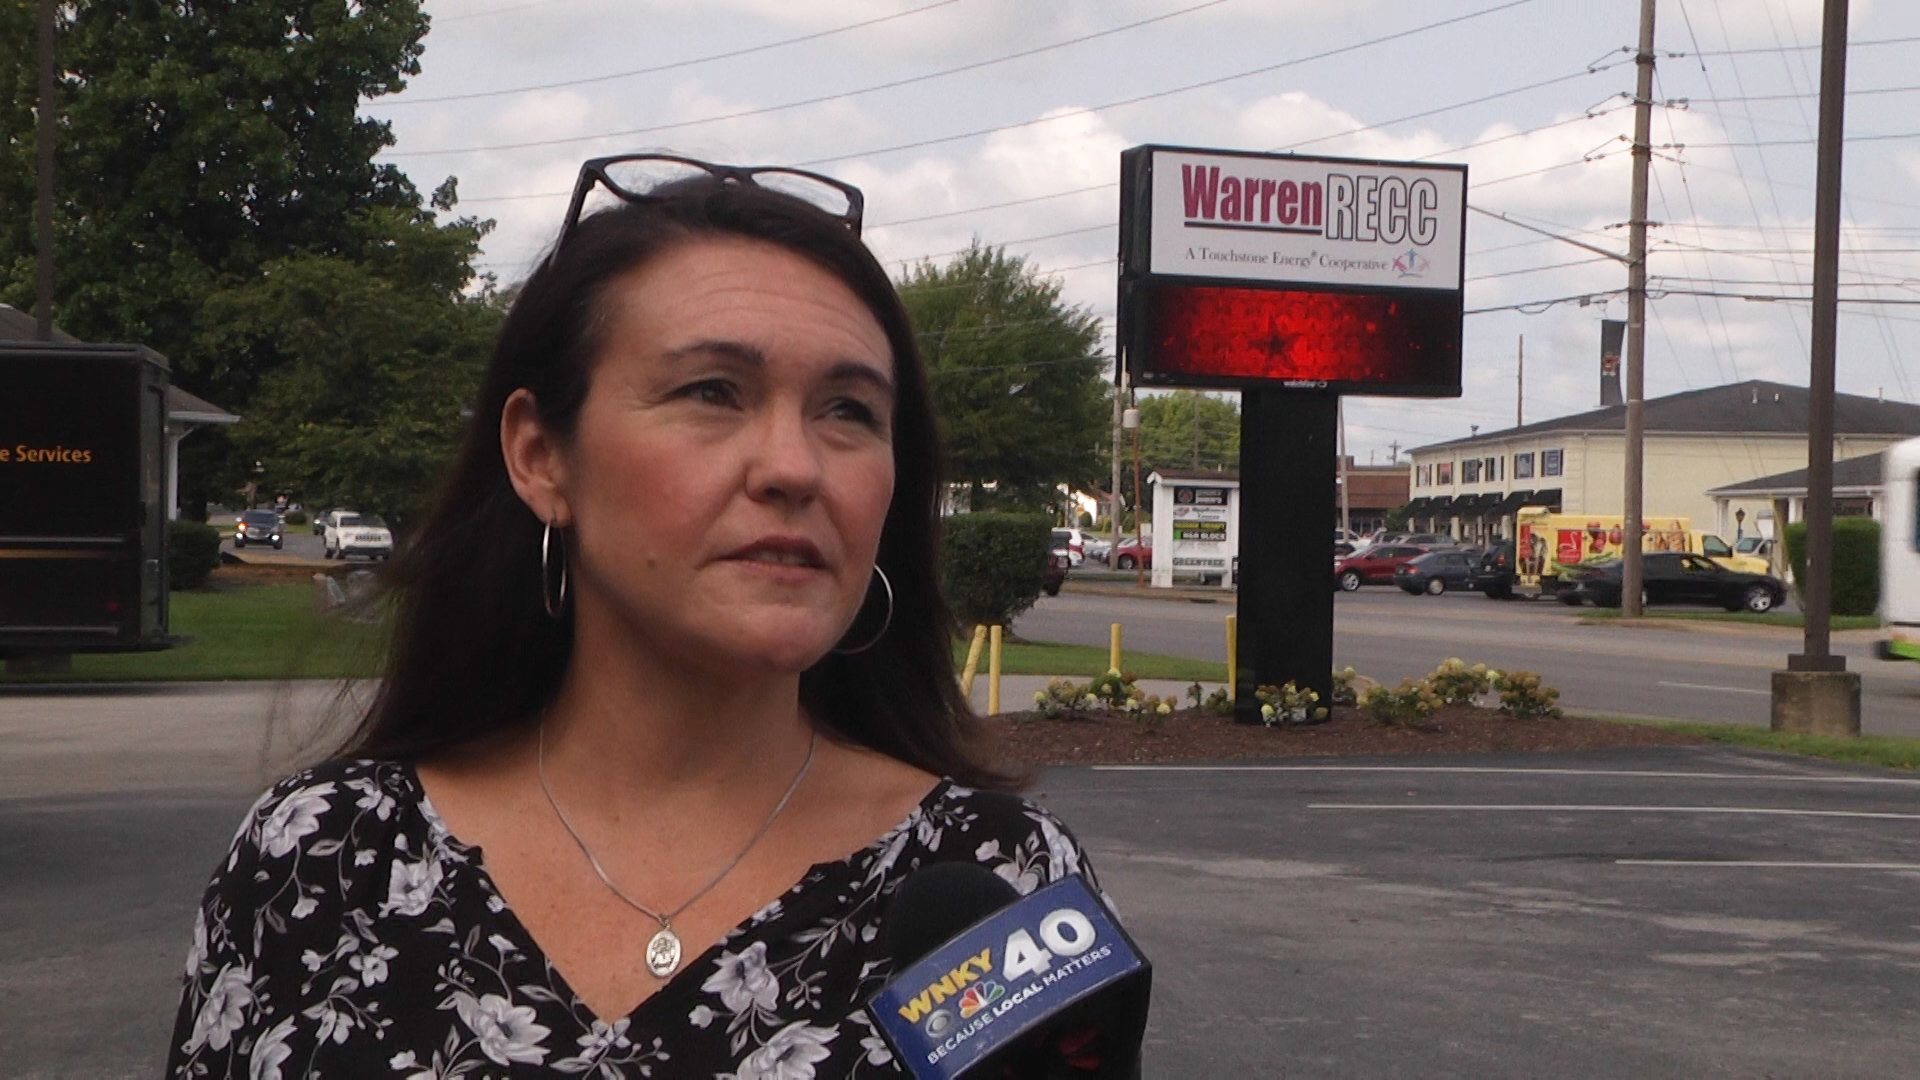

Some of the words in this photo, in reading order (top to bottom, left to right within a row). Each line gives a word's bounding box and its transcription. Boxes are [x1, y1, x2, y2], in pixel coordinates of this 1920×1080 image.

[1185, 248, 1196, 260] A
[1198, 247, 1269, 264] Touchstone
[1319, 253, 1389, 272] Cooperative
[15, 445, 93, 463] Services
[898, 946, 994, 1025] WNKY
[1002, 907, 1097, 983] 40
[926, 1012, 995, 1066] BECAUSE
[993, 983, 1044, 1018] LOCAL
